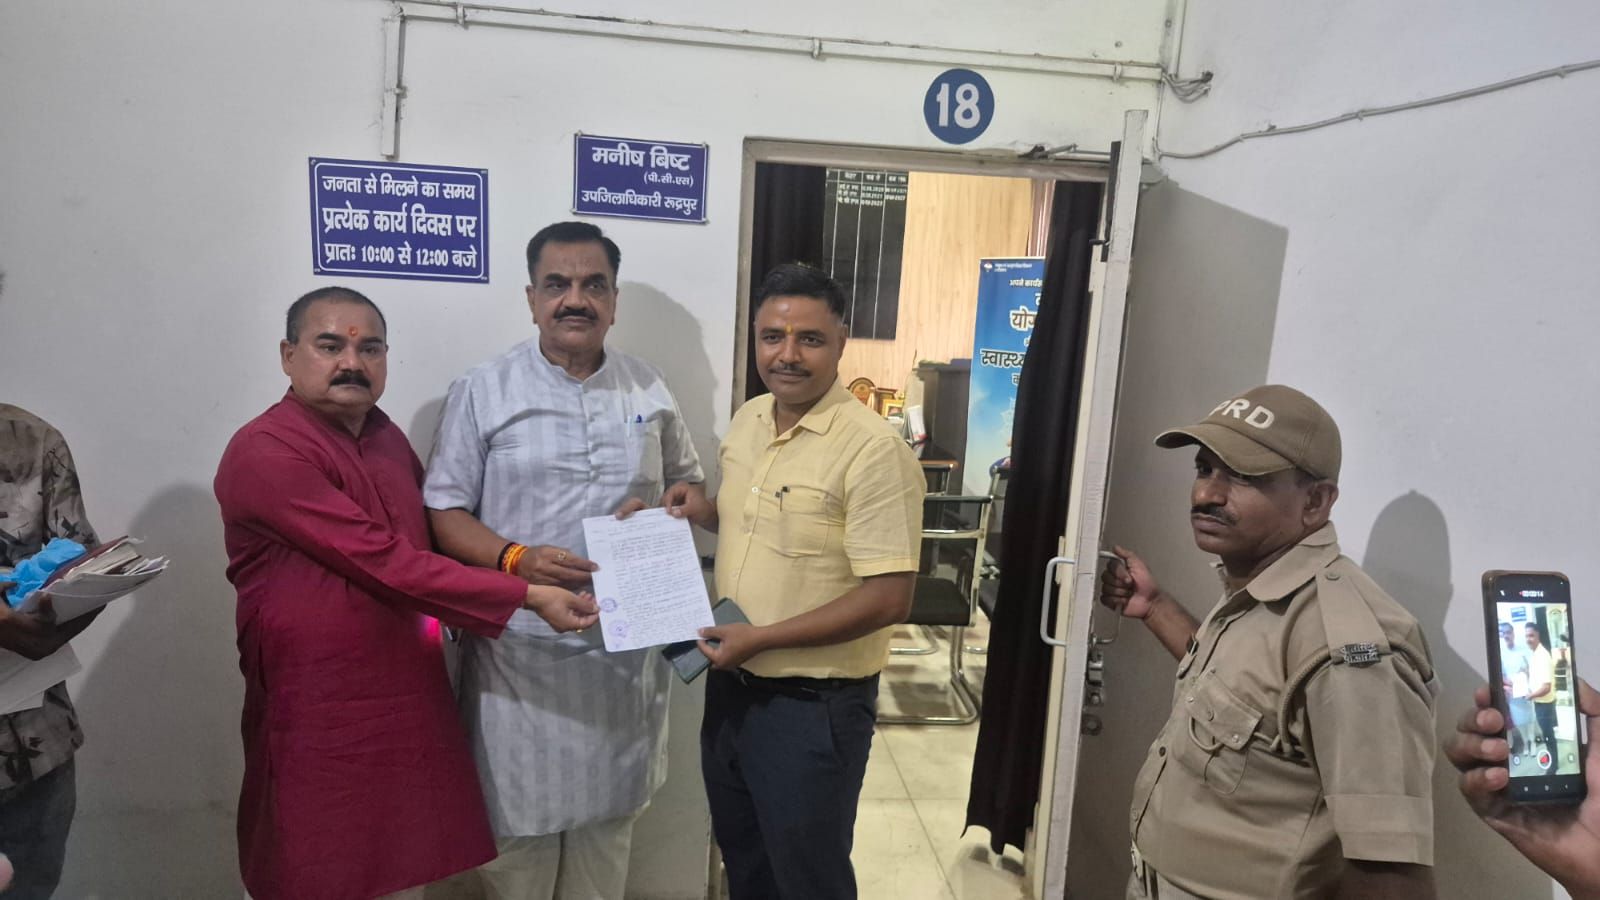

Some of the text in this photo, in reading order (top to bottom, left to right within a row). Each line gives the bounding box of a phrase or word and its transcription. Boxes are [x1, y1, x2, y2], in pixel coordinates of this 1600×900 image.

[936, 83, 980, 129] 18
[592, 142, 691, 171] मनीष बिष्ट
[322, 173, 476, 200] जनता से मिलने का समय
[581, 187, 662, 208] उपजिलाधिकारी
[322, 200, 477, 238] प्रत्येक कार्य दिवस पर
[361, 246, 395, 264] 10:00
[397, 241, 412, 265] से
[415, 248, 449, 267] 12:00
[452, 245, 477, 268] बजे
[1208, 398, 1275, 429] PRD
